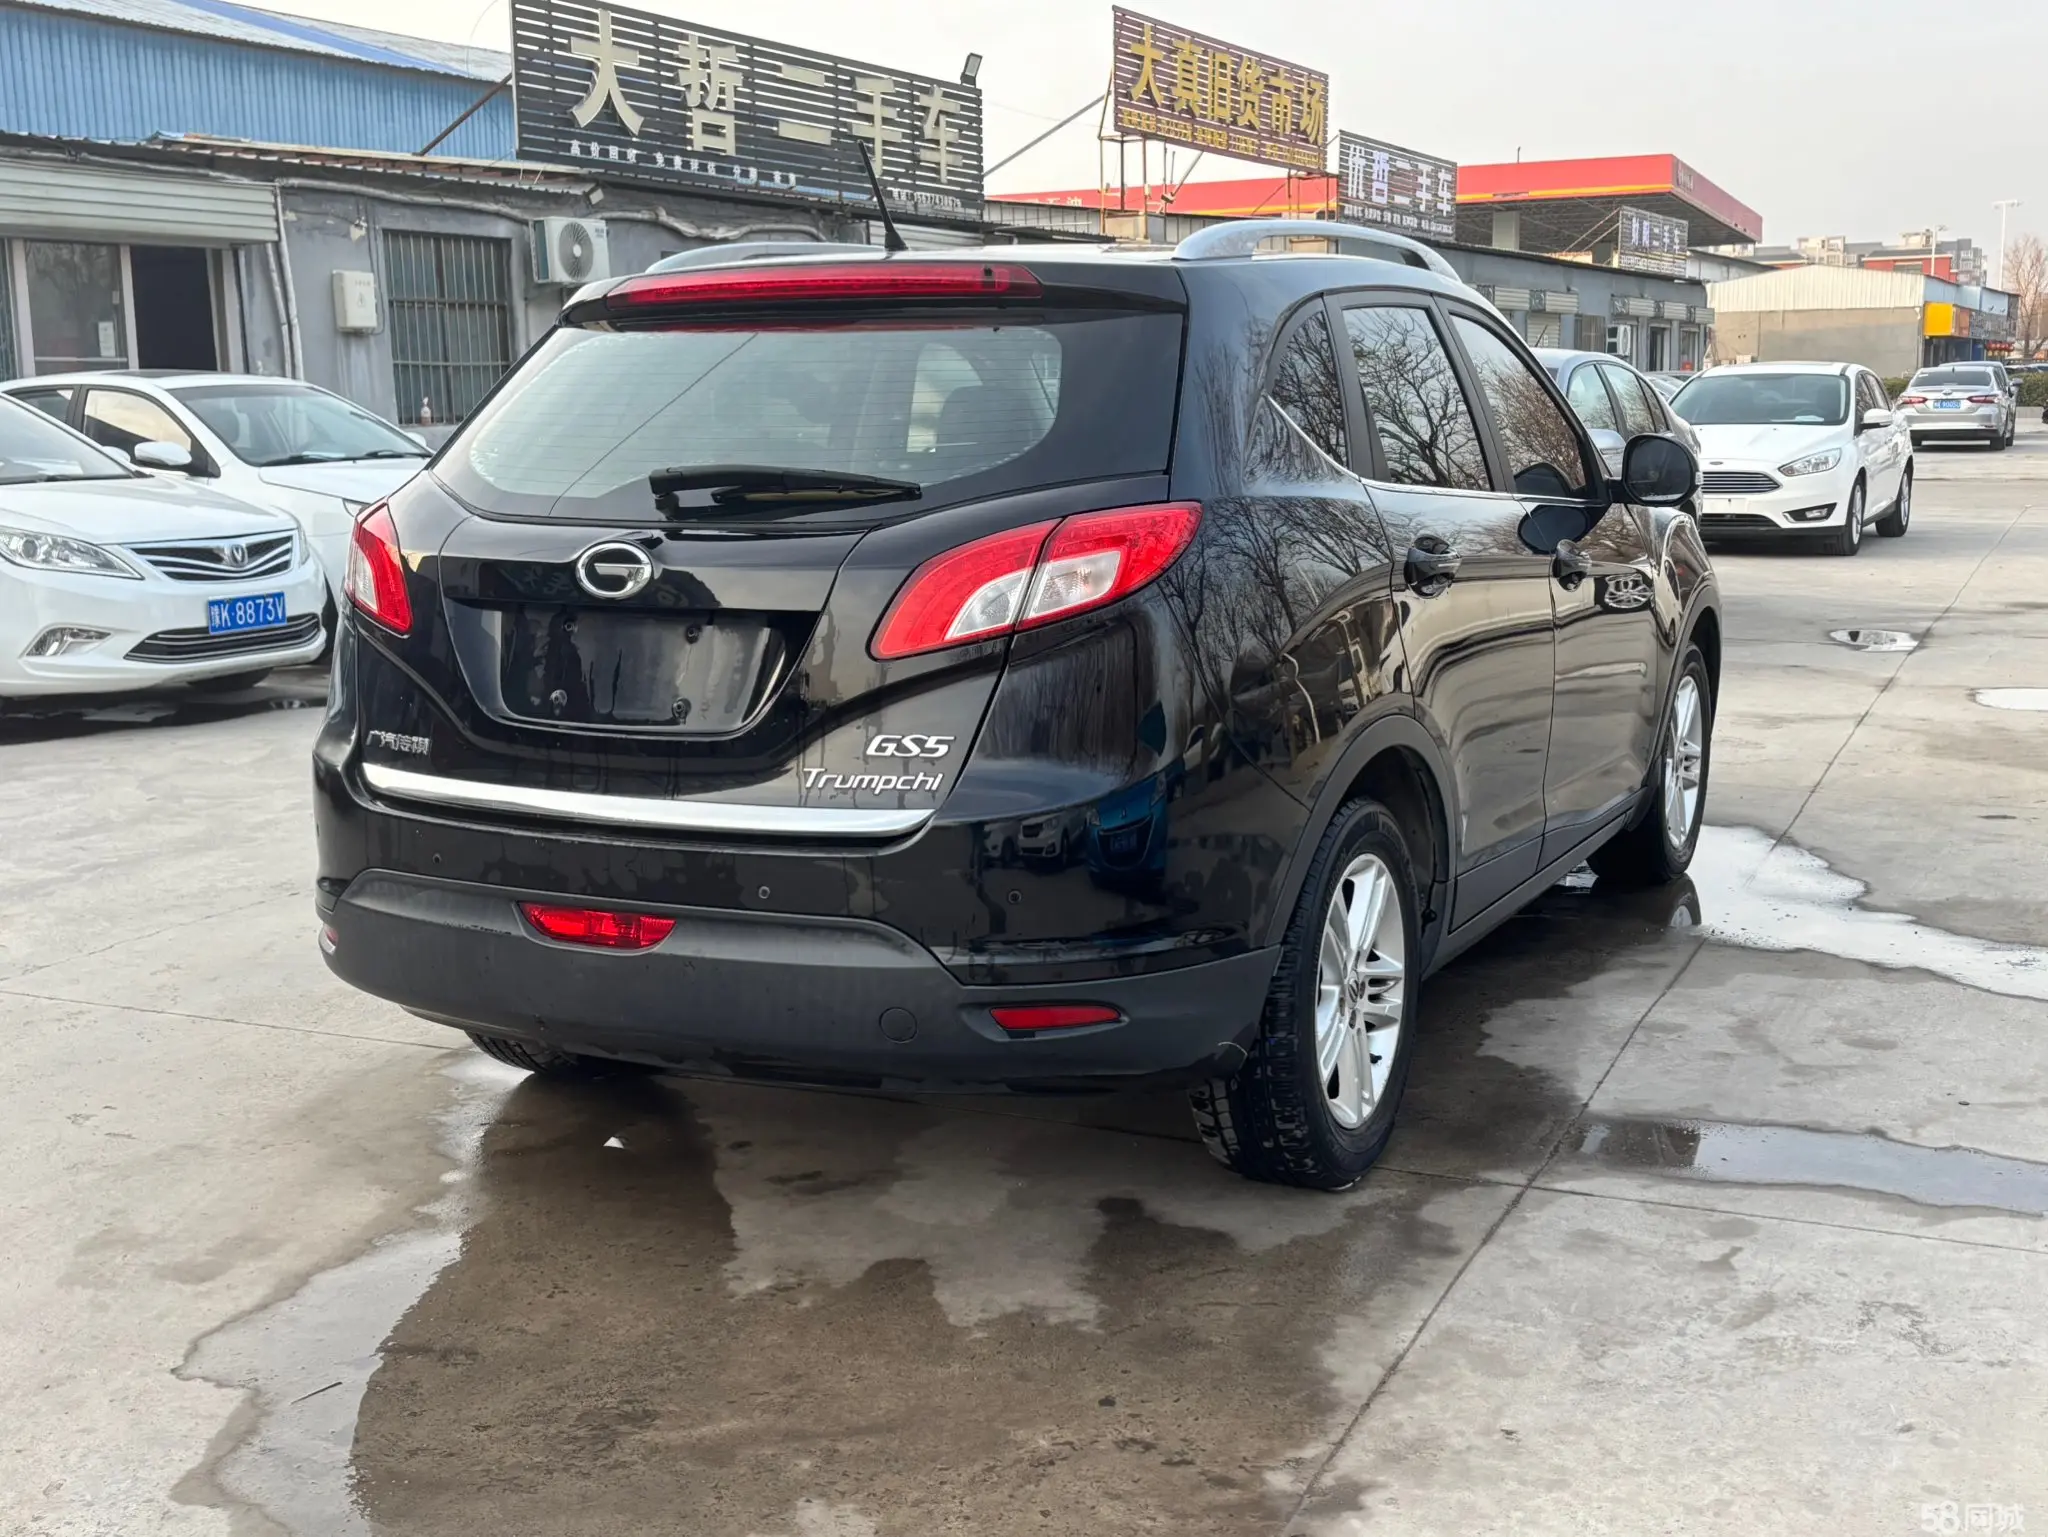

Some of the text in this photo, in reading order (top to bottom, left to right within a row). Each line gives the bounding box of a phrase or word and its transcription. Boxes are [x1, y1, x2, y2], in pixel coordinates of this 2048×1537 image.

[567, 8, 963, 184] 大哲二手车
[1129, 24, 1324, 146] 大真旧货市场
[866, 734, 955, 757] GS5
